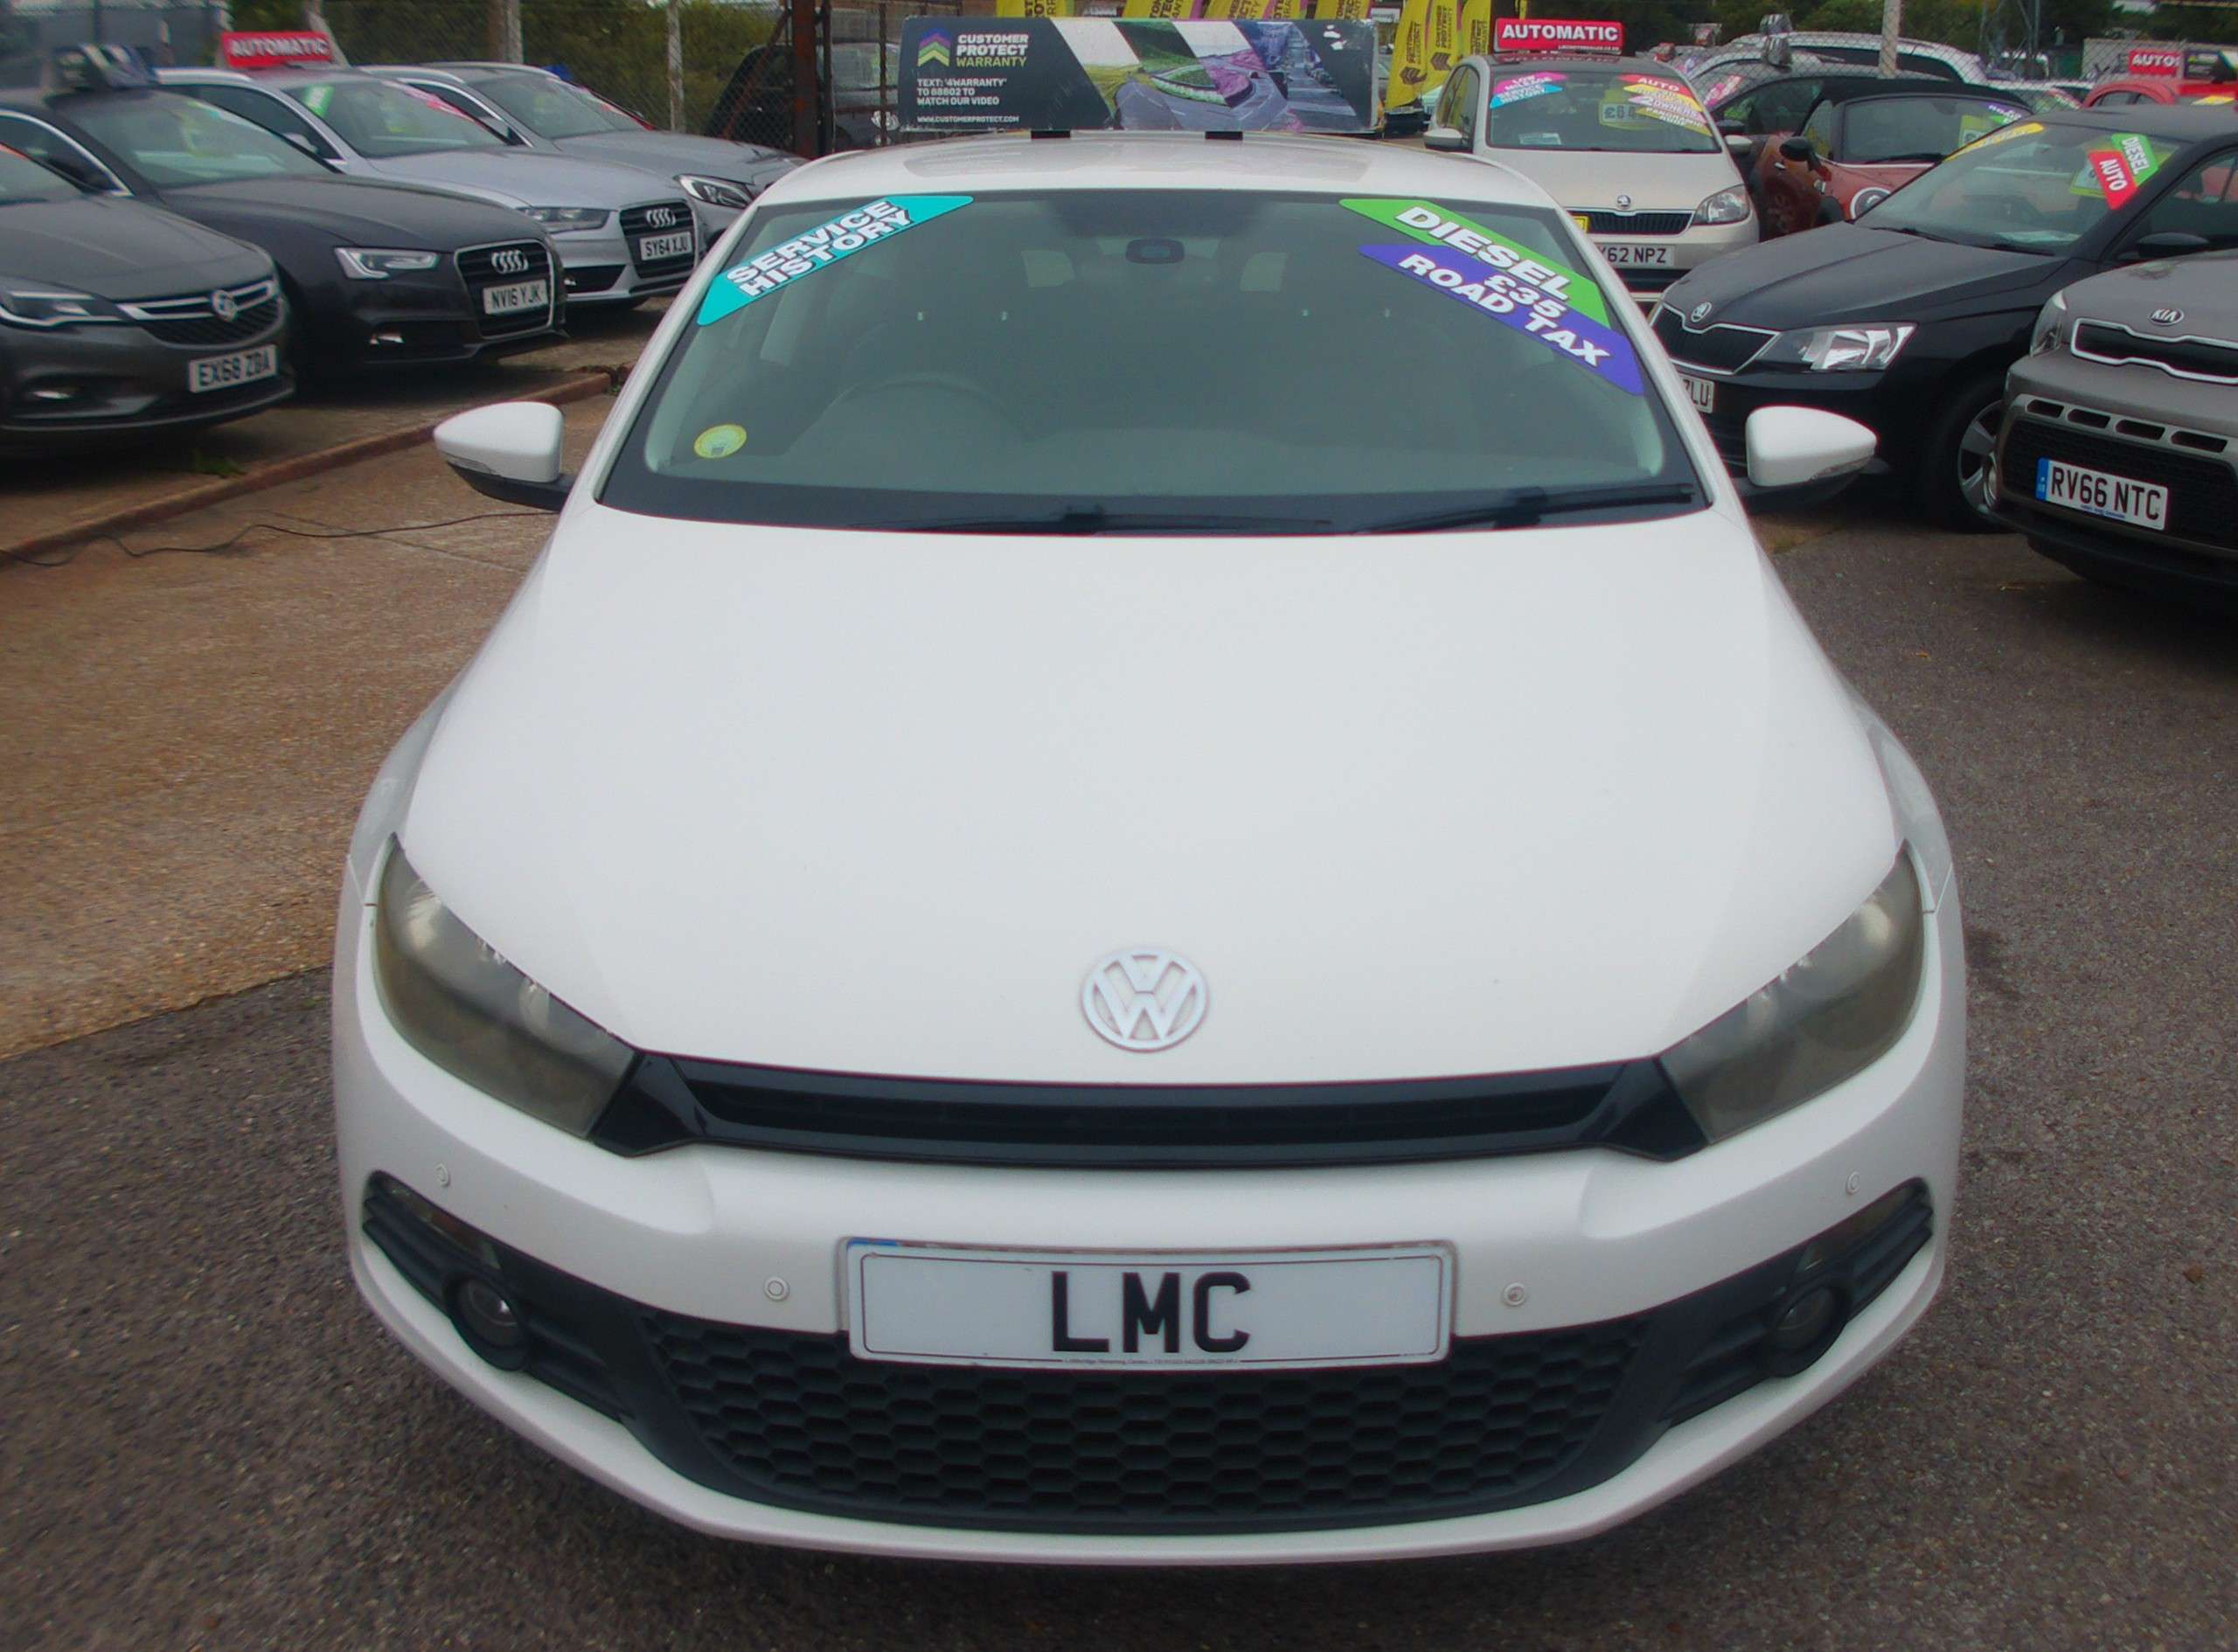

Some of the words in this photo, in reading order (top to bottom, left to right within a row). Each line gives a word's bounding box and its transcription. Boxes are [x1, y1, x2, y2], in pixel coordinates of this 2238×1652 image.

[957, 34, 1029, 44] CUSTOMER
[1502, 24, 1618, 41] AUTOMATIC
[231, 38, 329, 57] AUTOMATIC
[956, 45, 1029, 56] PROTECT
[956, 57, 1027, 67] WARRANTY
[917, 87, 929, 96] TO
[963, 87, 976, 96] TO
[1637, 77, 1679, 92] AUTO
[917, 96, 949, 106] WATCH
[950, 96, 970, 105] OUR
[971, 96, 999, 105] VIDEO
[2122, 136, 2150, 175] DIESEL
[2100, 158, 2128, 191] AUTO
[726, 201, 899, 284] SERVICE
[739, 210, 913, 297] HISTORY
[1395, 206, 1572, 302] DIESEL
[1633, 247, 1667, 263] NPZ
[491, 288, 518, 309] NV16
[1484, 274, 1568, 319] £35
[1398, 253, 1515, 314] ROAD
[1525, 312, 1611, 367] TAX
[2151, 308, 2178, 323] KIA
[198, 357, 241, 386] EX68
[2051, 466, 2108, 508] RV66
[2114, 482, 2162, 521] NTC
[1052, 1271, 1251, 1355] LMC
